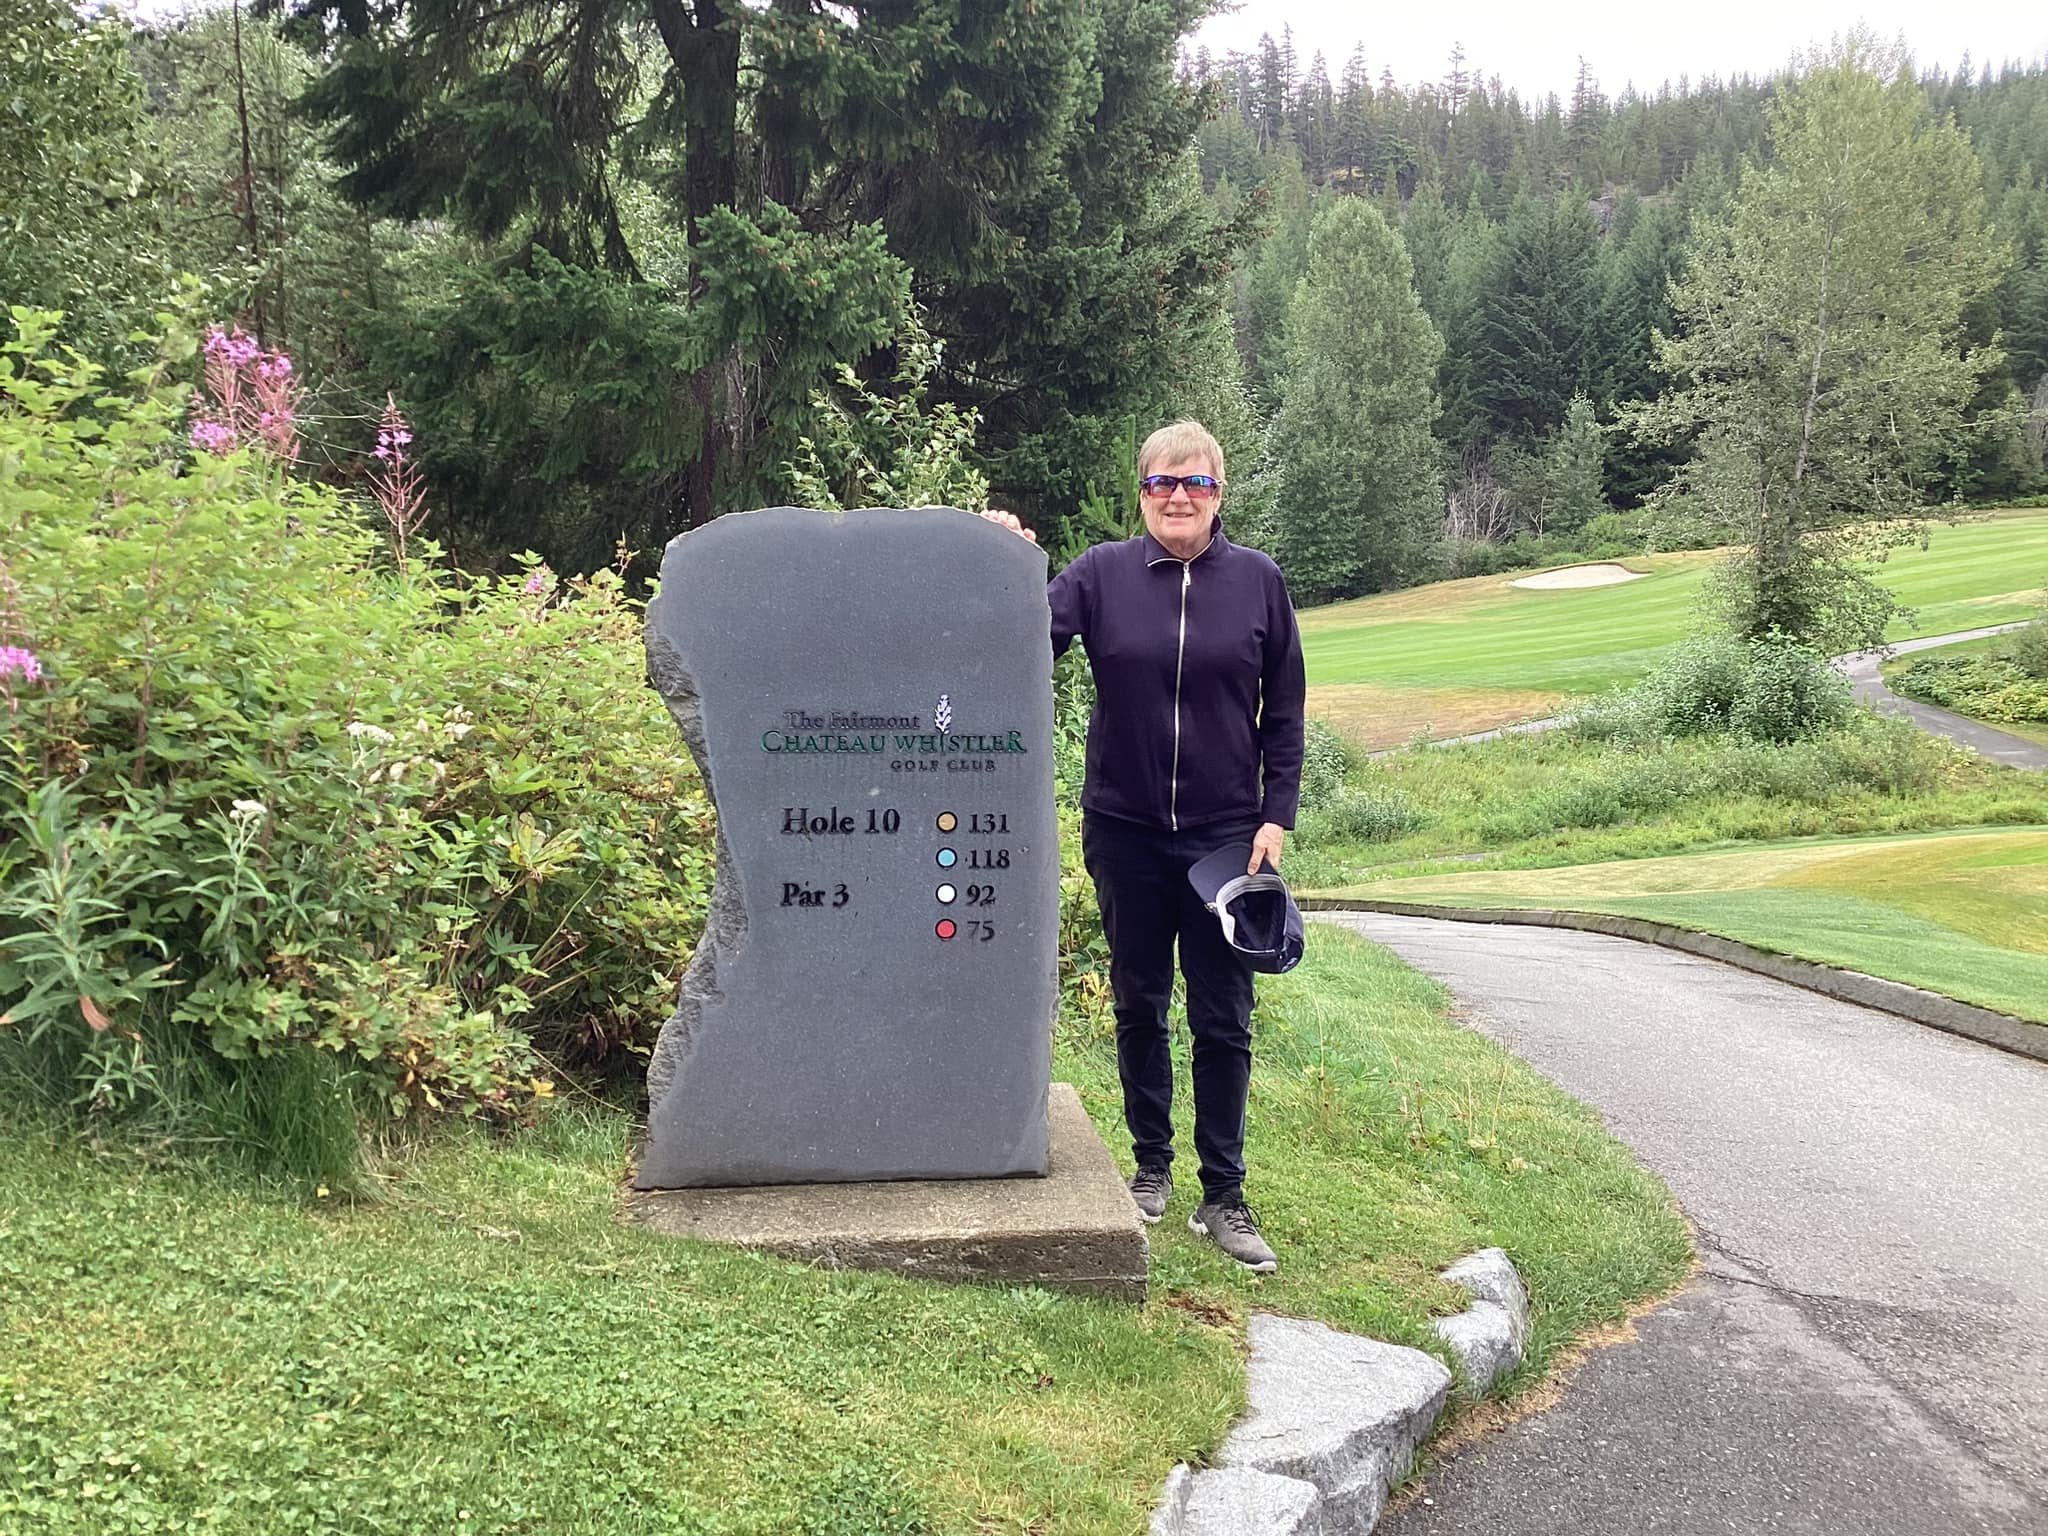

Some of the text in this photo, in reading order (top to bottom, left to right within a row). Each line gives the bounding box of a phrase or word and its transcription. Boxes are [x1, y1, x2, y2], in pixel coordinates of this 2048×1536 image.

[784, 711, 921, 729] The Fairmont
[760, 730, 1027, 754] CHATEAU WHISTLER
[890, 760, 996, 772] GOLF CLUB
[780, 807, 900, 834] Hole 10
[968, 813, 1011, 833] 131
[967, 849, 1011, 869] 118
[780, 883, 850, 907] Par 3
[966, 885, 996, 906] 92
[966, 921, 996, 941] 75
